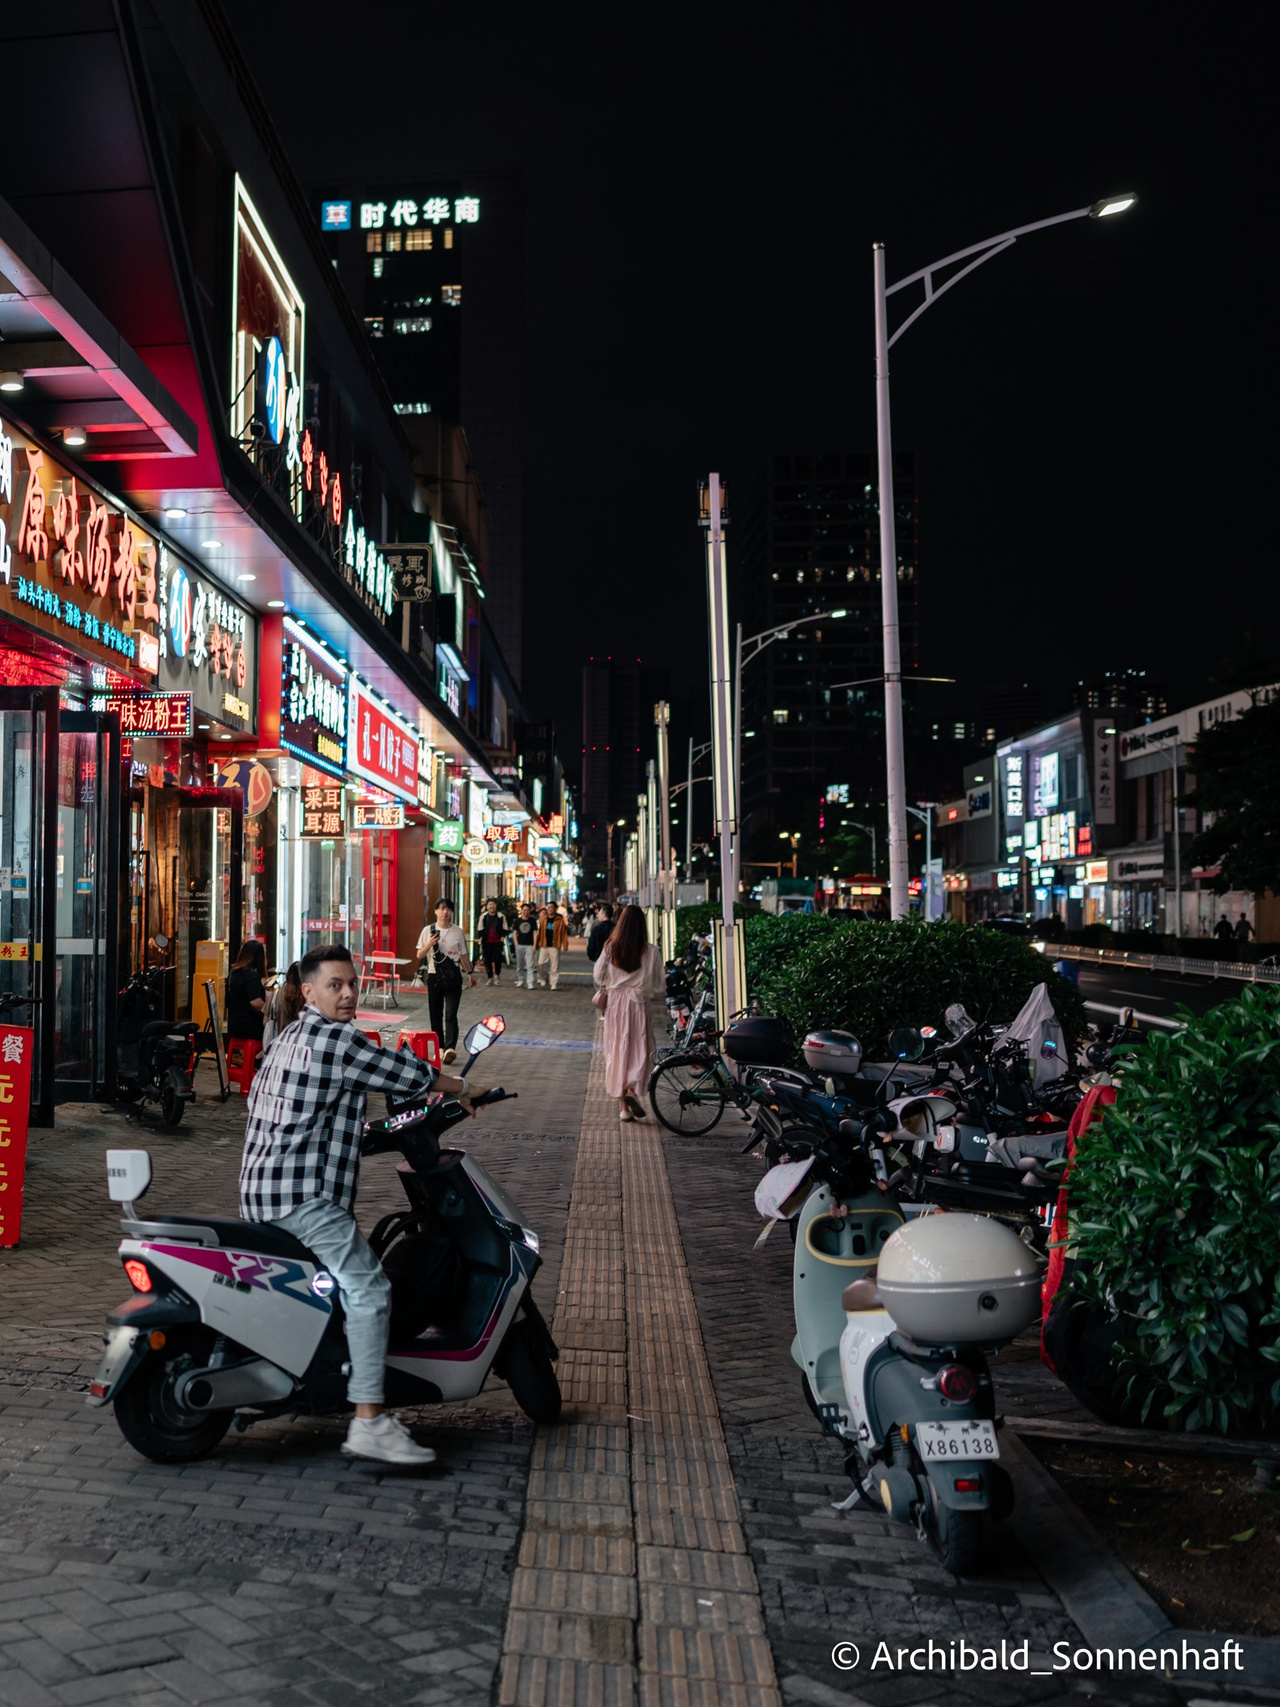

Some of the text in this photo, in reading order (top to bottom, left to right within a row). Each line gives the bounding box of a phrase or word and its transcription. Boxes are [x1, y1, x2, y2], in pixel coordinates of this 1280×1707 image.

[360, 197, 480, 228] 时代华商
[19, 449, 159, 623] 原味汤粉王
[18, 576, 61, 618] 汕头牛肉丸
[363, 711, 401, 777] 孔一凡饺子
[1100, 744, 1111, 796] 中国银行
[305, 789, 341, 810] 采耳
[304, 813, 341, 834] 耳源
[439, 826, 458, 847] 药
[487, 826, 519, 841] 取痣
[925, 1438, 994, 1456] X86138
